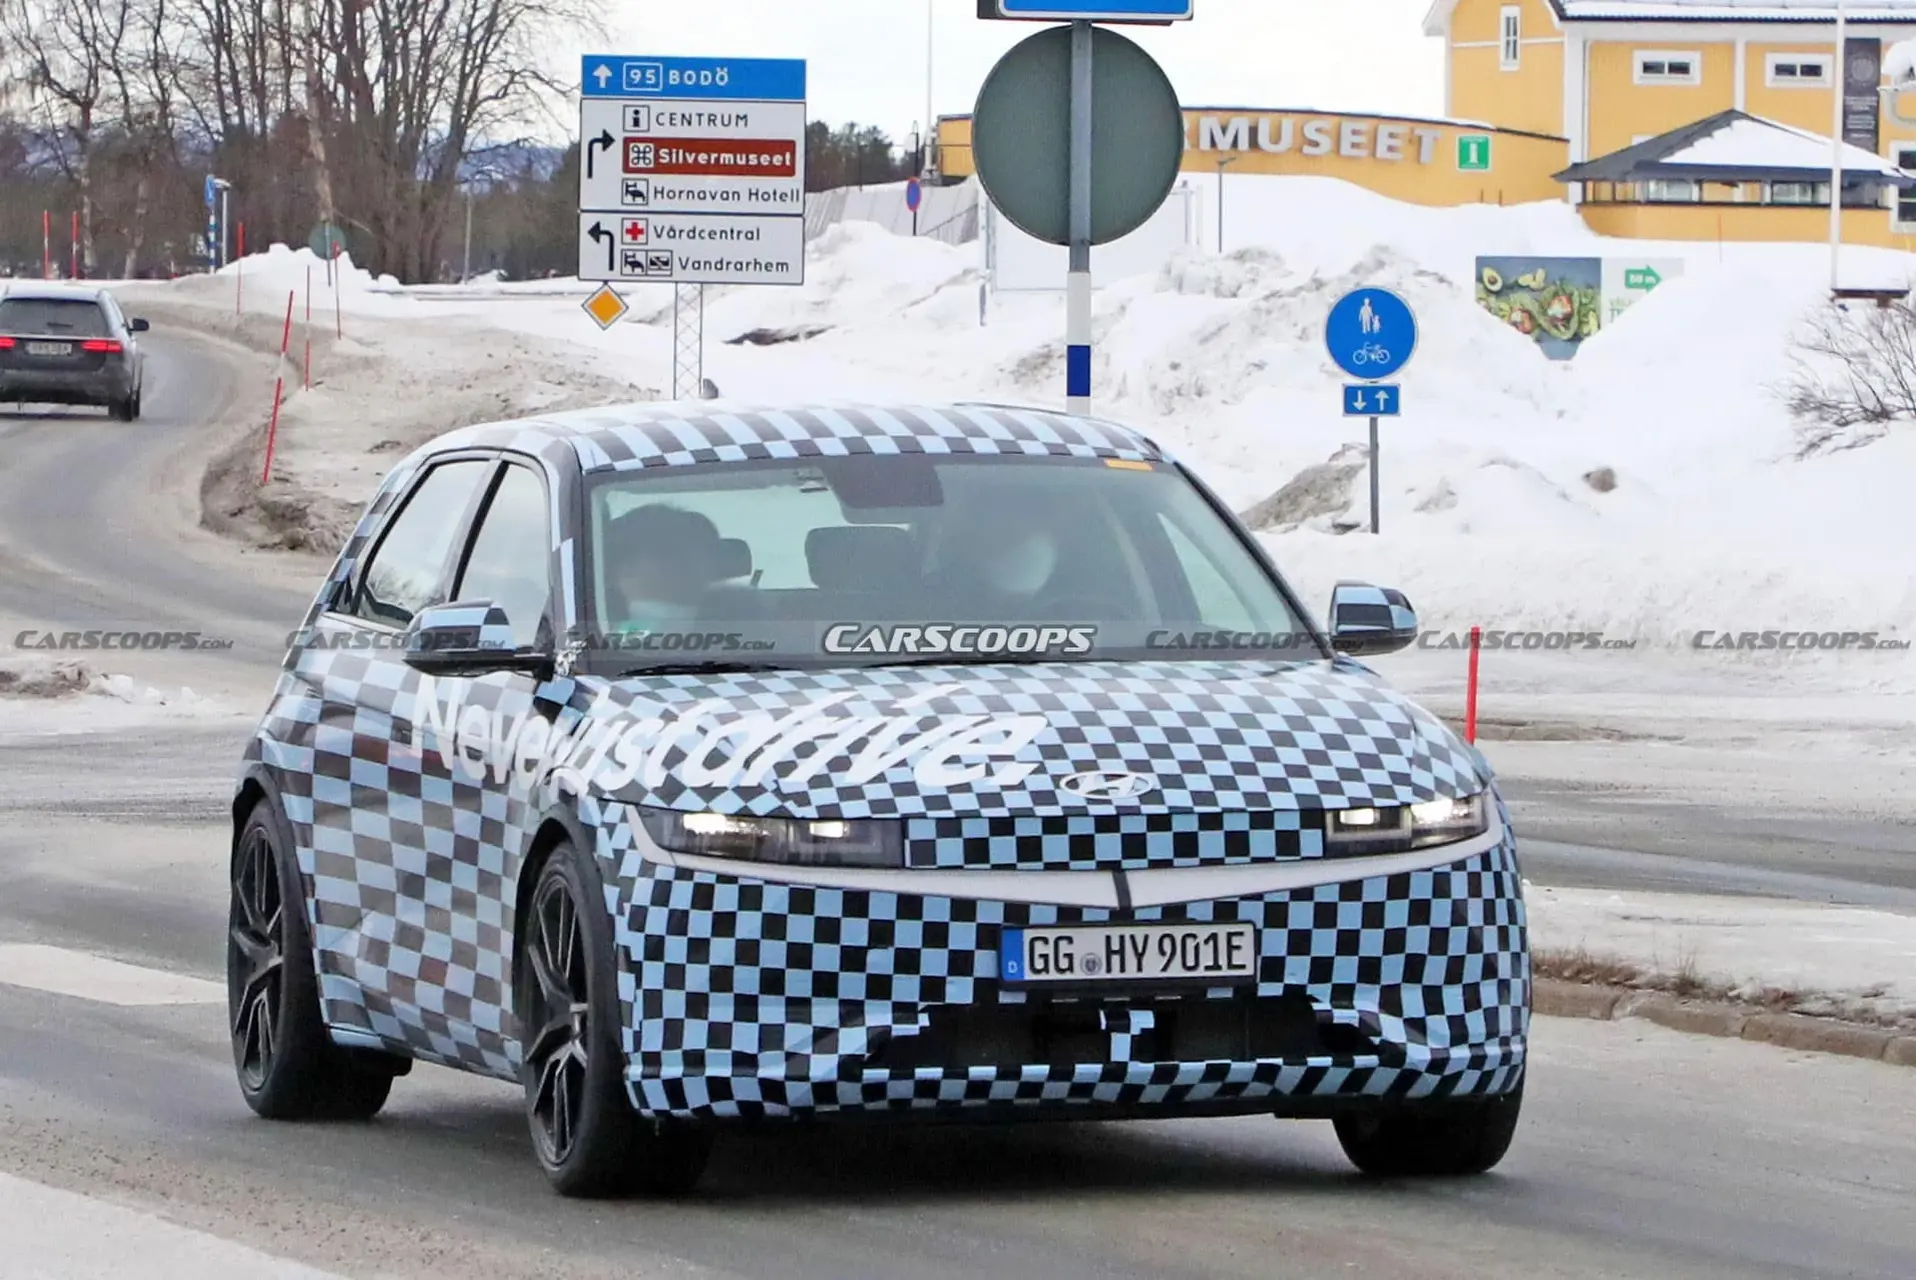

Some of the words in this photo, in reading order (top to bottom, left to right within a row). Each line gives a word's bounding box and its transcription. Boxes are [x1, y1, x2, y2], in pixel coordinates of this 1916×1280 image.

[629, 69, 657, 84] 95
[668, 68, 729, 86] BODÖ
[655, 112, 749, 128] CENTRUM
[1183, 116, 1442, 164] MUSEET
[658, 149, 792, 166] Silvermuseet
[653, 186, 741, 202] Hornavan
[748, 188, 800, 203] Hotell
[653, 225, 761, 241] Vårdcentral
[677, 256, 790, 273] Vandrarhem
[1028, 935, 1075, 975] GG
[1105, 933, 1150, 974] HY
[1157, 931, 1247, 973] 901E
